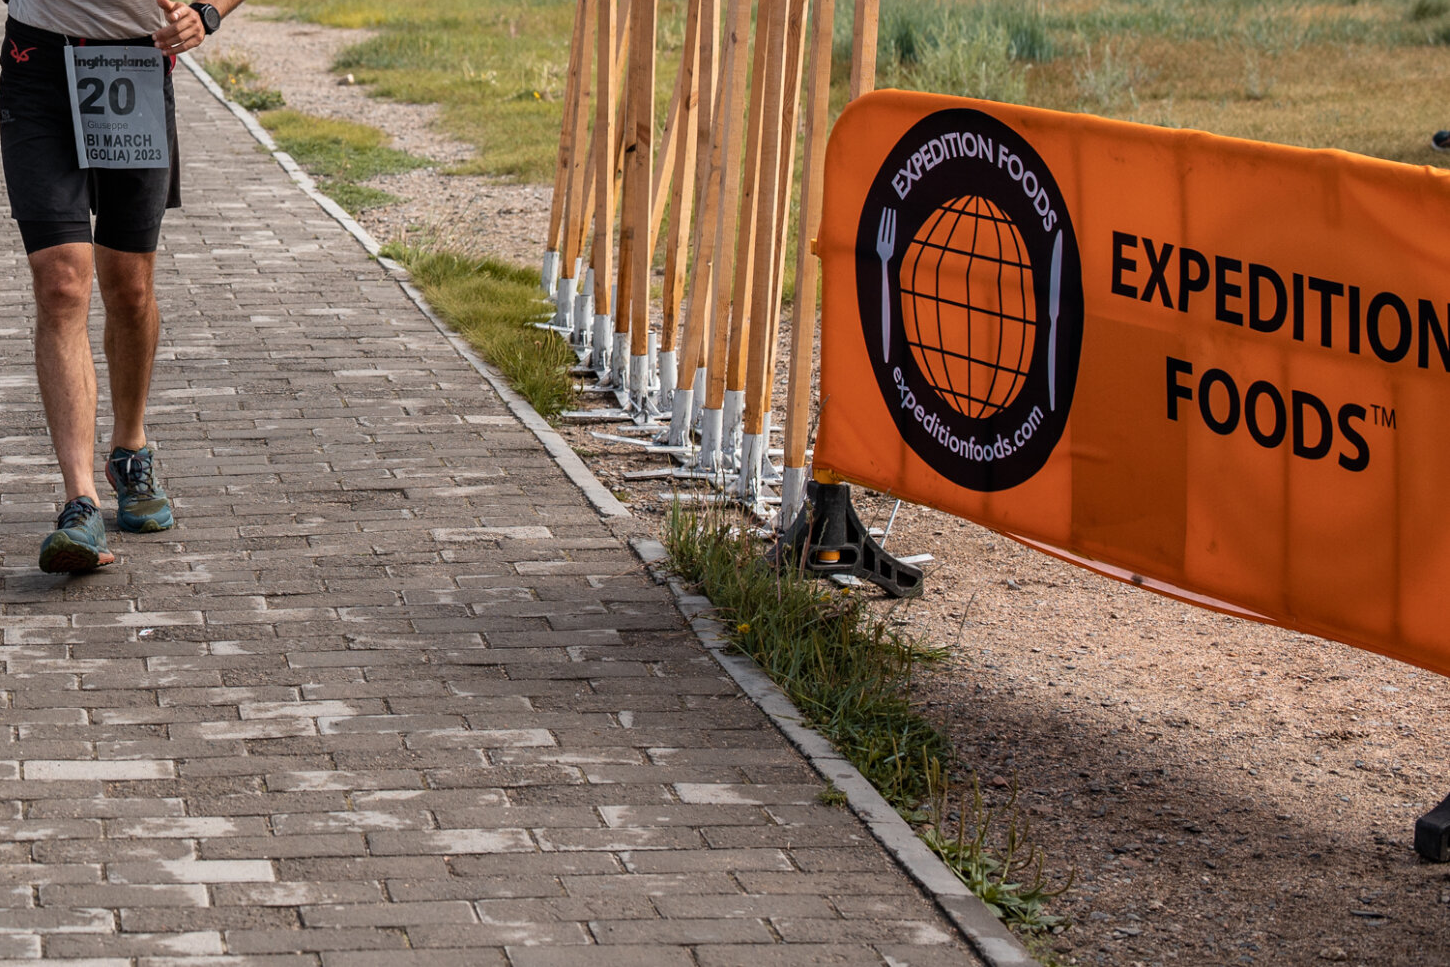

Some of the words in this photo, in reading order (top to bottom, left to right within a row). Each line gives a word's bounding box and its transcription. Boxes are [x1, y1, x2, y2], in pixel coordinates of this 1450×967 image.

[77, 77, 136, 116] 20
[84, 133, 99, 147] BI
[103, 133, 152, 147] MARCH
[87, 120, 129, 131] Giuseppe
[134, 148, 162, 161] 2023
[891, 132, 993, 200] EXPEDITION
[998, 143, 1058, 232] FOODS
[1110, 230, 1450, 373] EXPEDITION
[893, 366, 1044, 462] expeditionfoods.com
